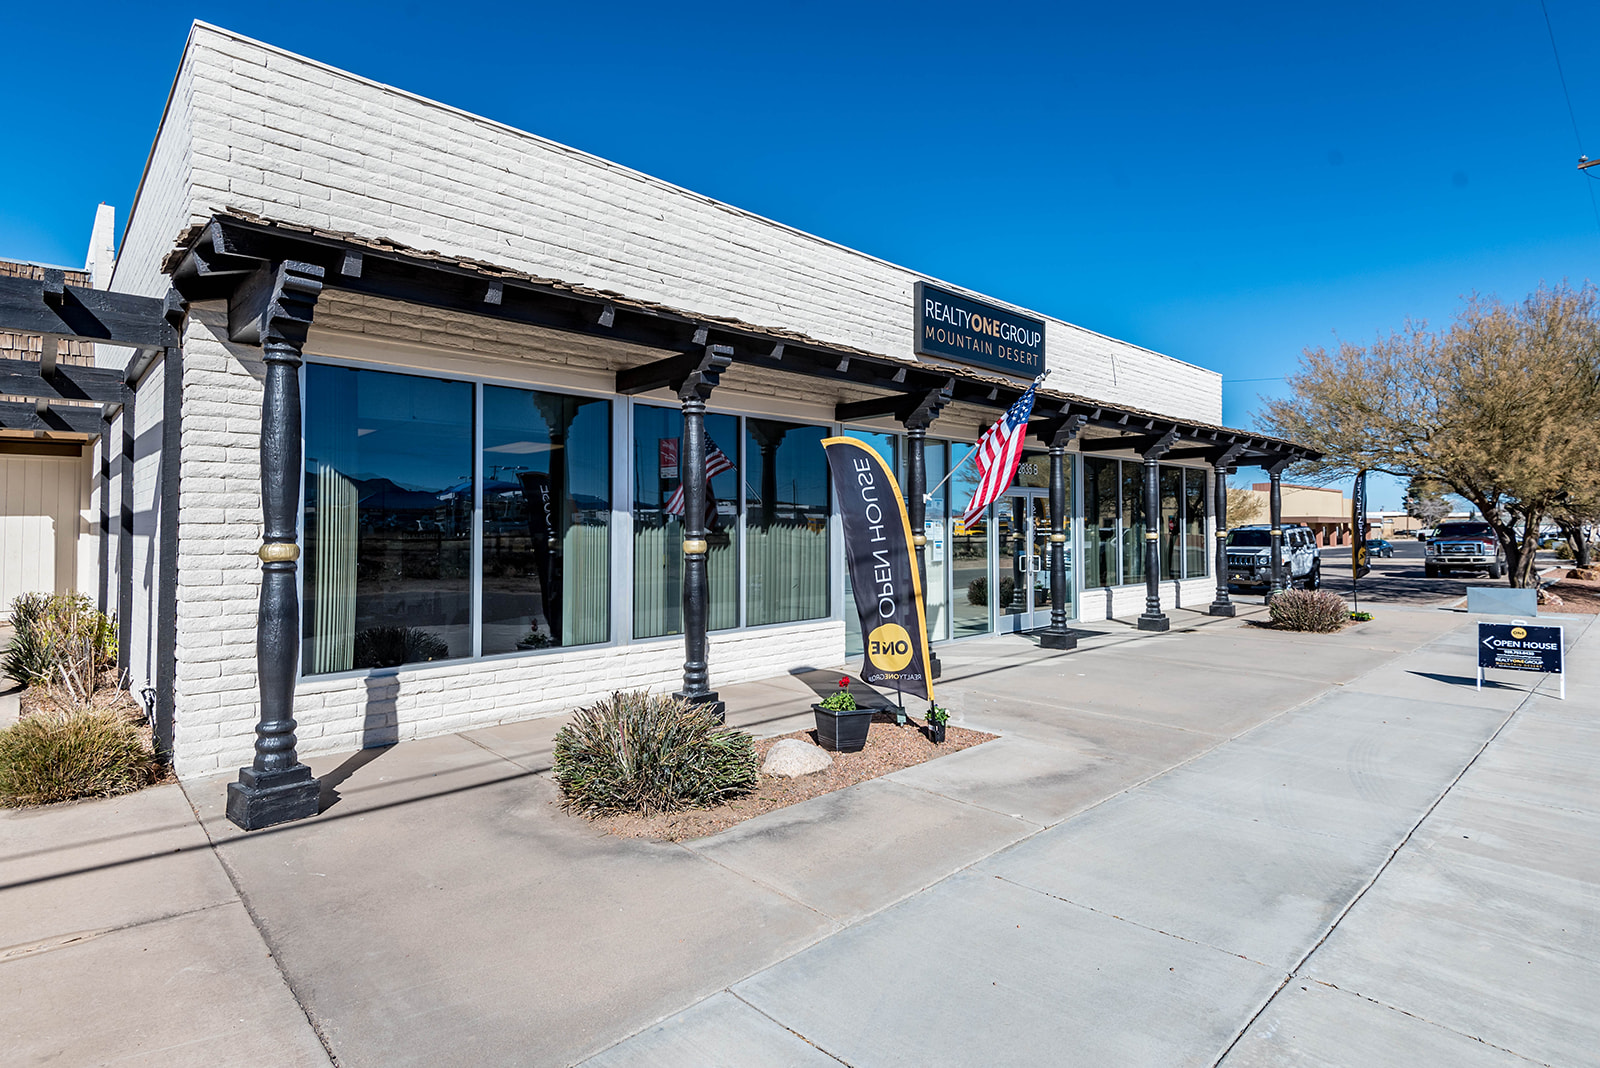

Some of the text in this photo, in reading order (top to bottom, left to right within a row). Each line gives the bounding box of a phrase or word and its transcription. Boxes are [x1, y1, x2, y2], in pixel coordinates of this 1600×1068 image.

[925, 298, 1041, 348] REALTYONEGROUP
[925, 325, 1039, 366] MOUNTAIN DESERT
[1493, 639, 1558, 650] OPEN HOUSE
